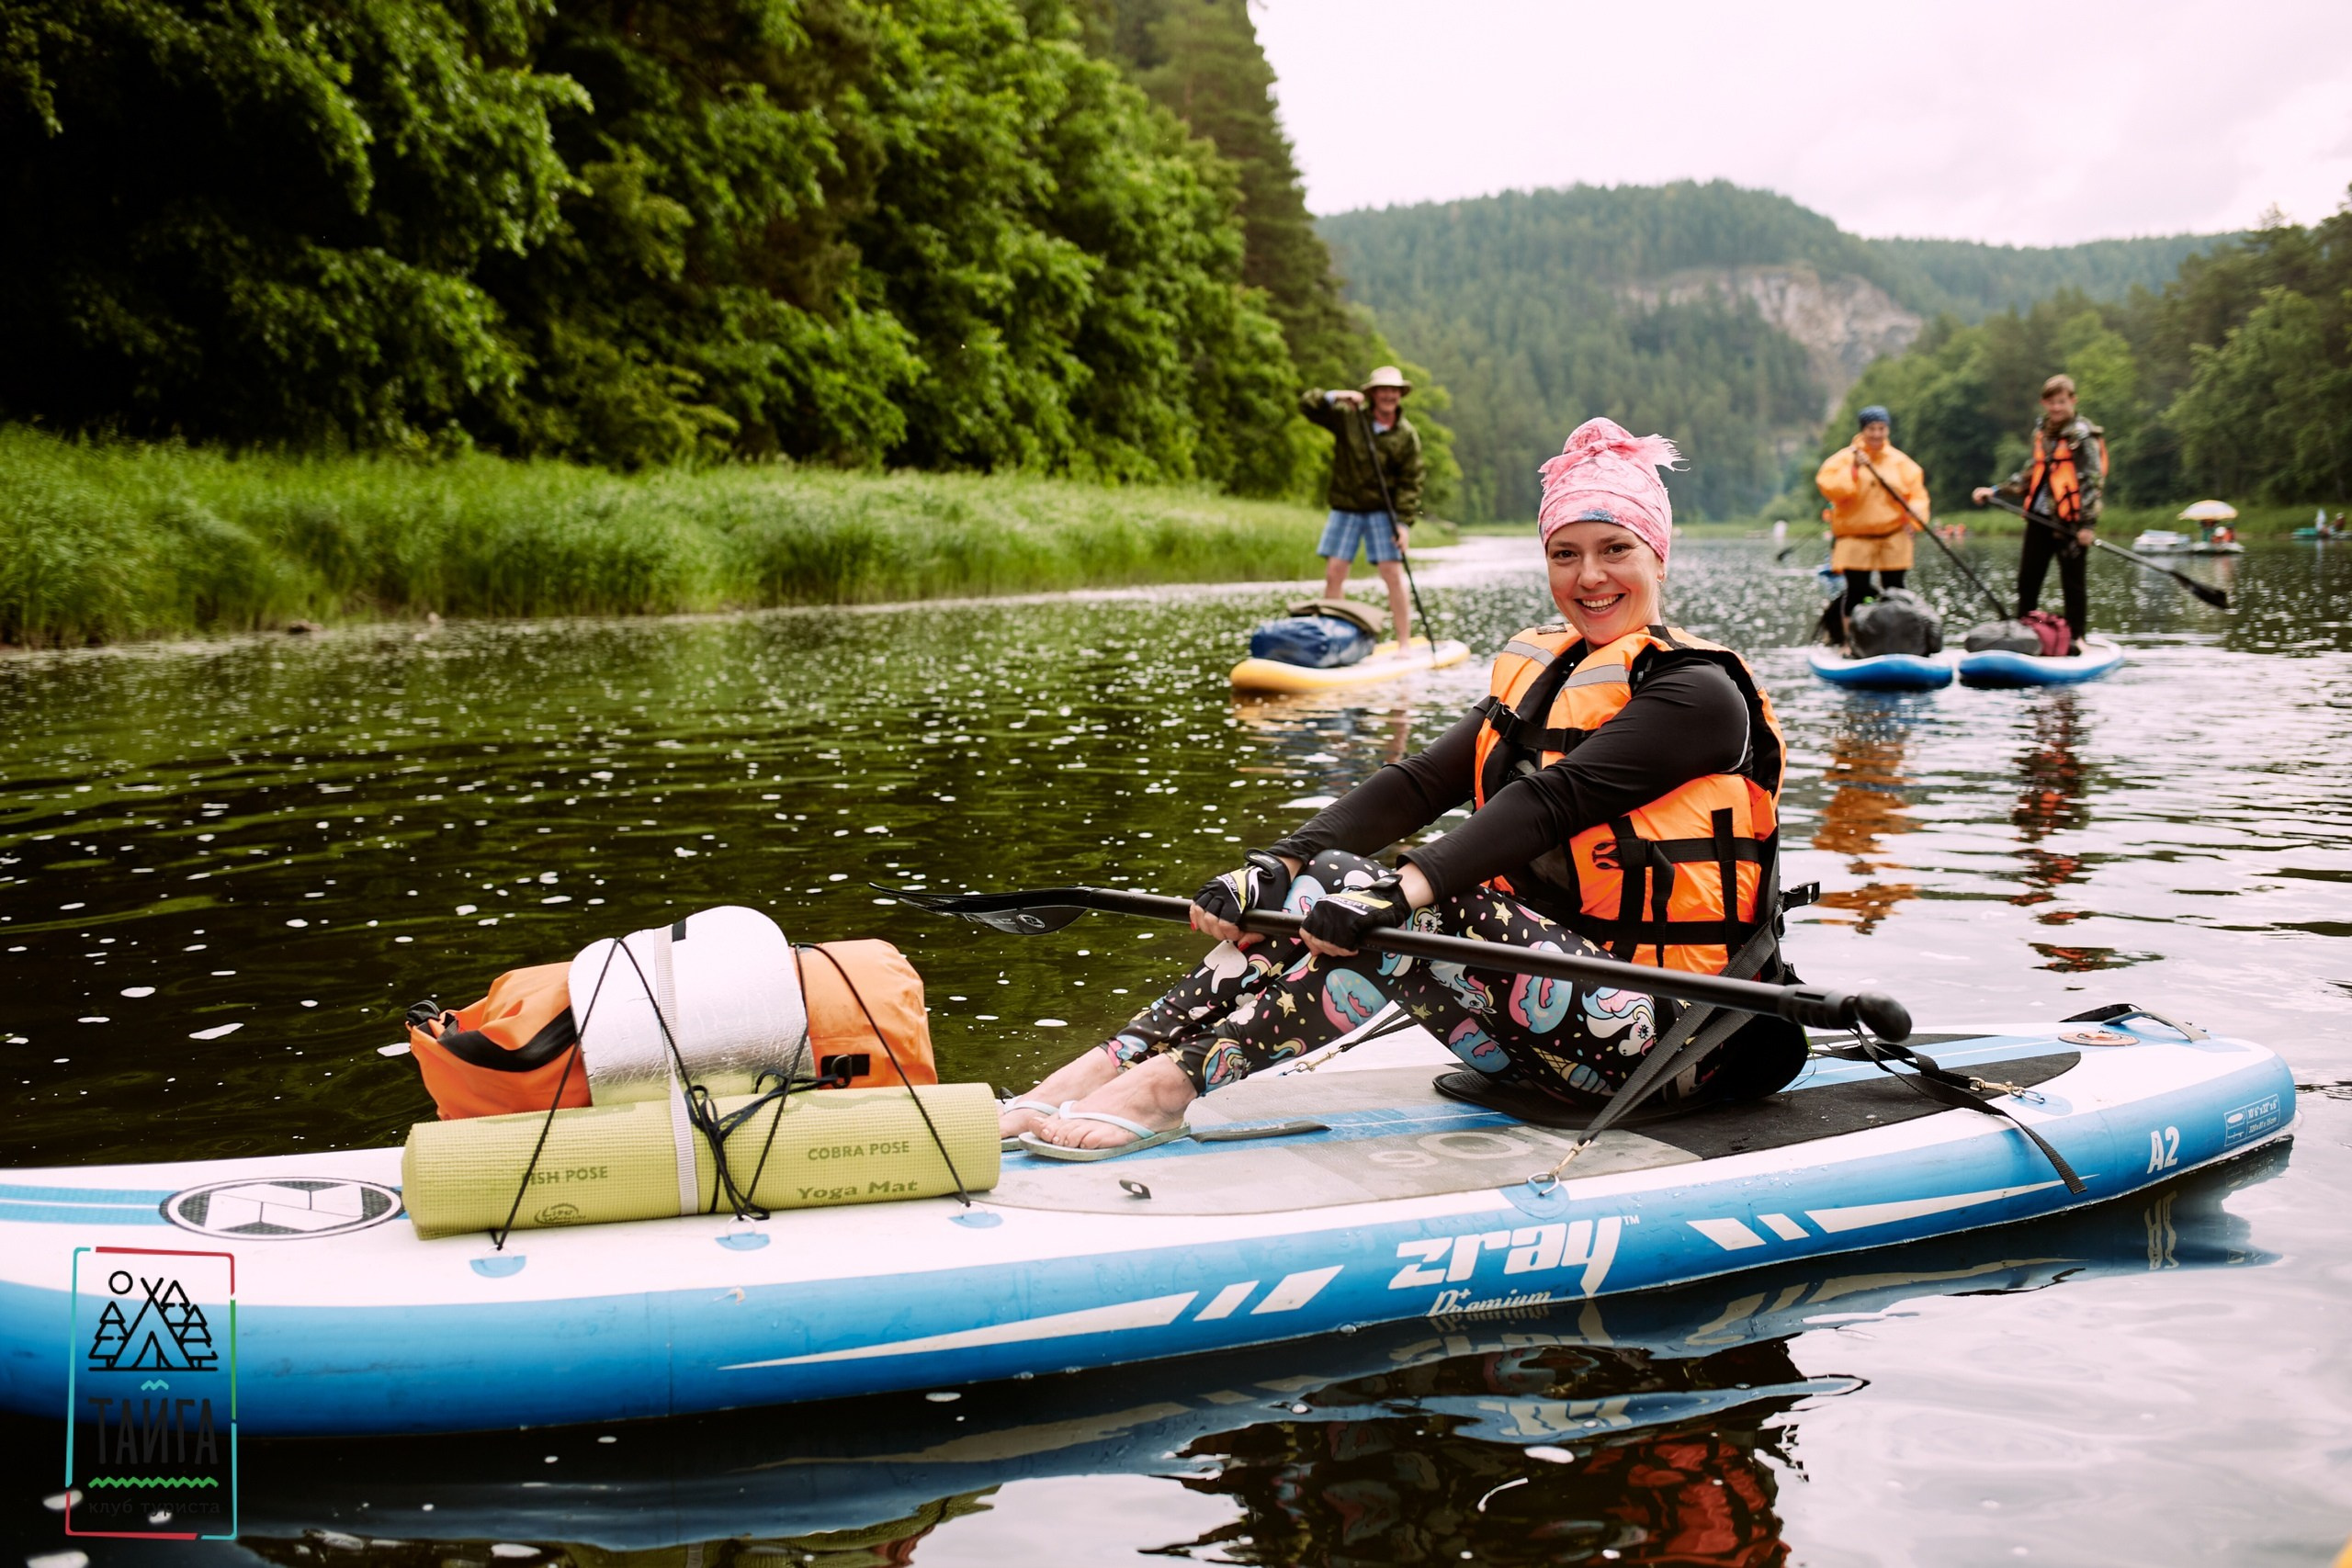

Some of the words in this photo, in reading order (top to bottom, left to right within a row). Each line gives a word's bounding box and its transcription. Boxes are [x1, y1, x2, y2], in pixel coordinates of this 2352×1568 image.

[808, 1145, 865, 1160] COBRA
[869, 1141, 910, 1155] POSE
[2146, 1126, 2180, 1175] A2
[566, 1166, 608, 1182] POSE
[797, 1187, 858, 1200] Yoga
[868, 1179, 918, 1193] Mat
[1388, 1216, 1622, 1299] zray
